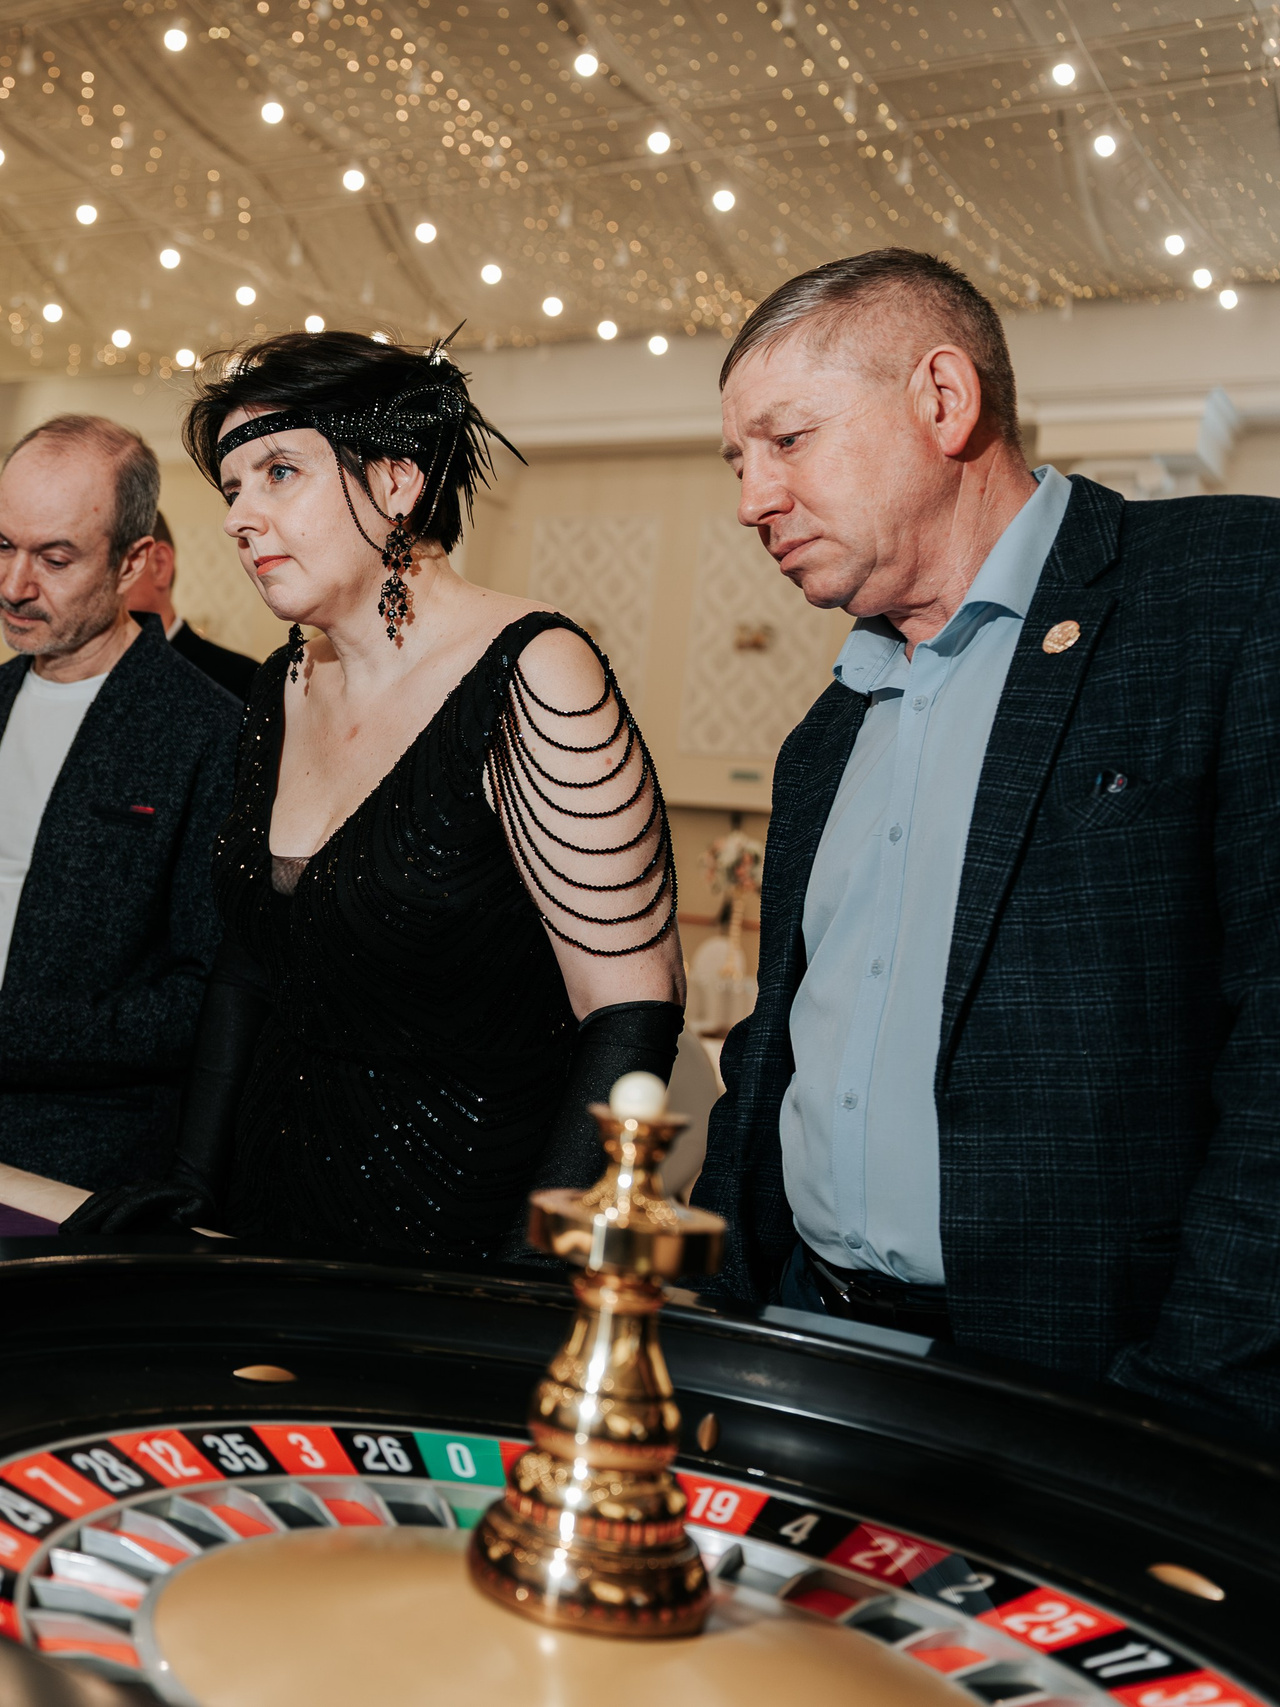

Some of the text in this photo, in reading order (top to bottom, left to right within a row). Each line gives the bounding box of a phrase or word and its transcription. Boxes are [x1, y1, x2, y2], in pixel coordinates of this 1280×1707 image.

[137, 1438, 202, 1479] 12
[202, 1433, 270, 1473] 35
[288, 1432, 327, 1469] 3
[353, 1435, 414, 1472] 26
[445, 1442, 477, 1479] 0
[71, 1448, 145, 1493] 28
[689, 1485, 741, 1525] 19
[779, 1513, 820, 1546] 4
[849, 1536, 921, 1576] 21
[938, 1573, 996, 1604] 2
[1003, 1602, 1099, 1645] 25
[1082, 1642, 1172, 1679] 17
